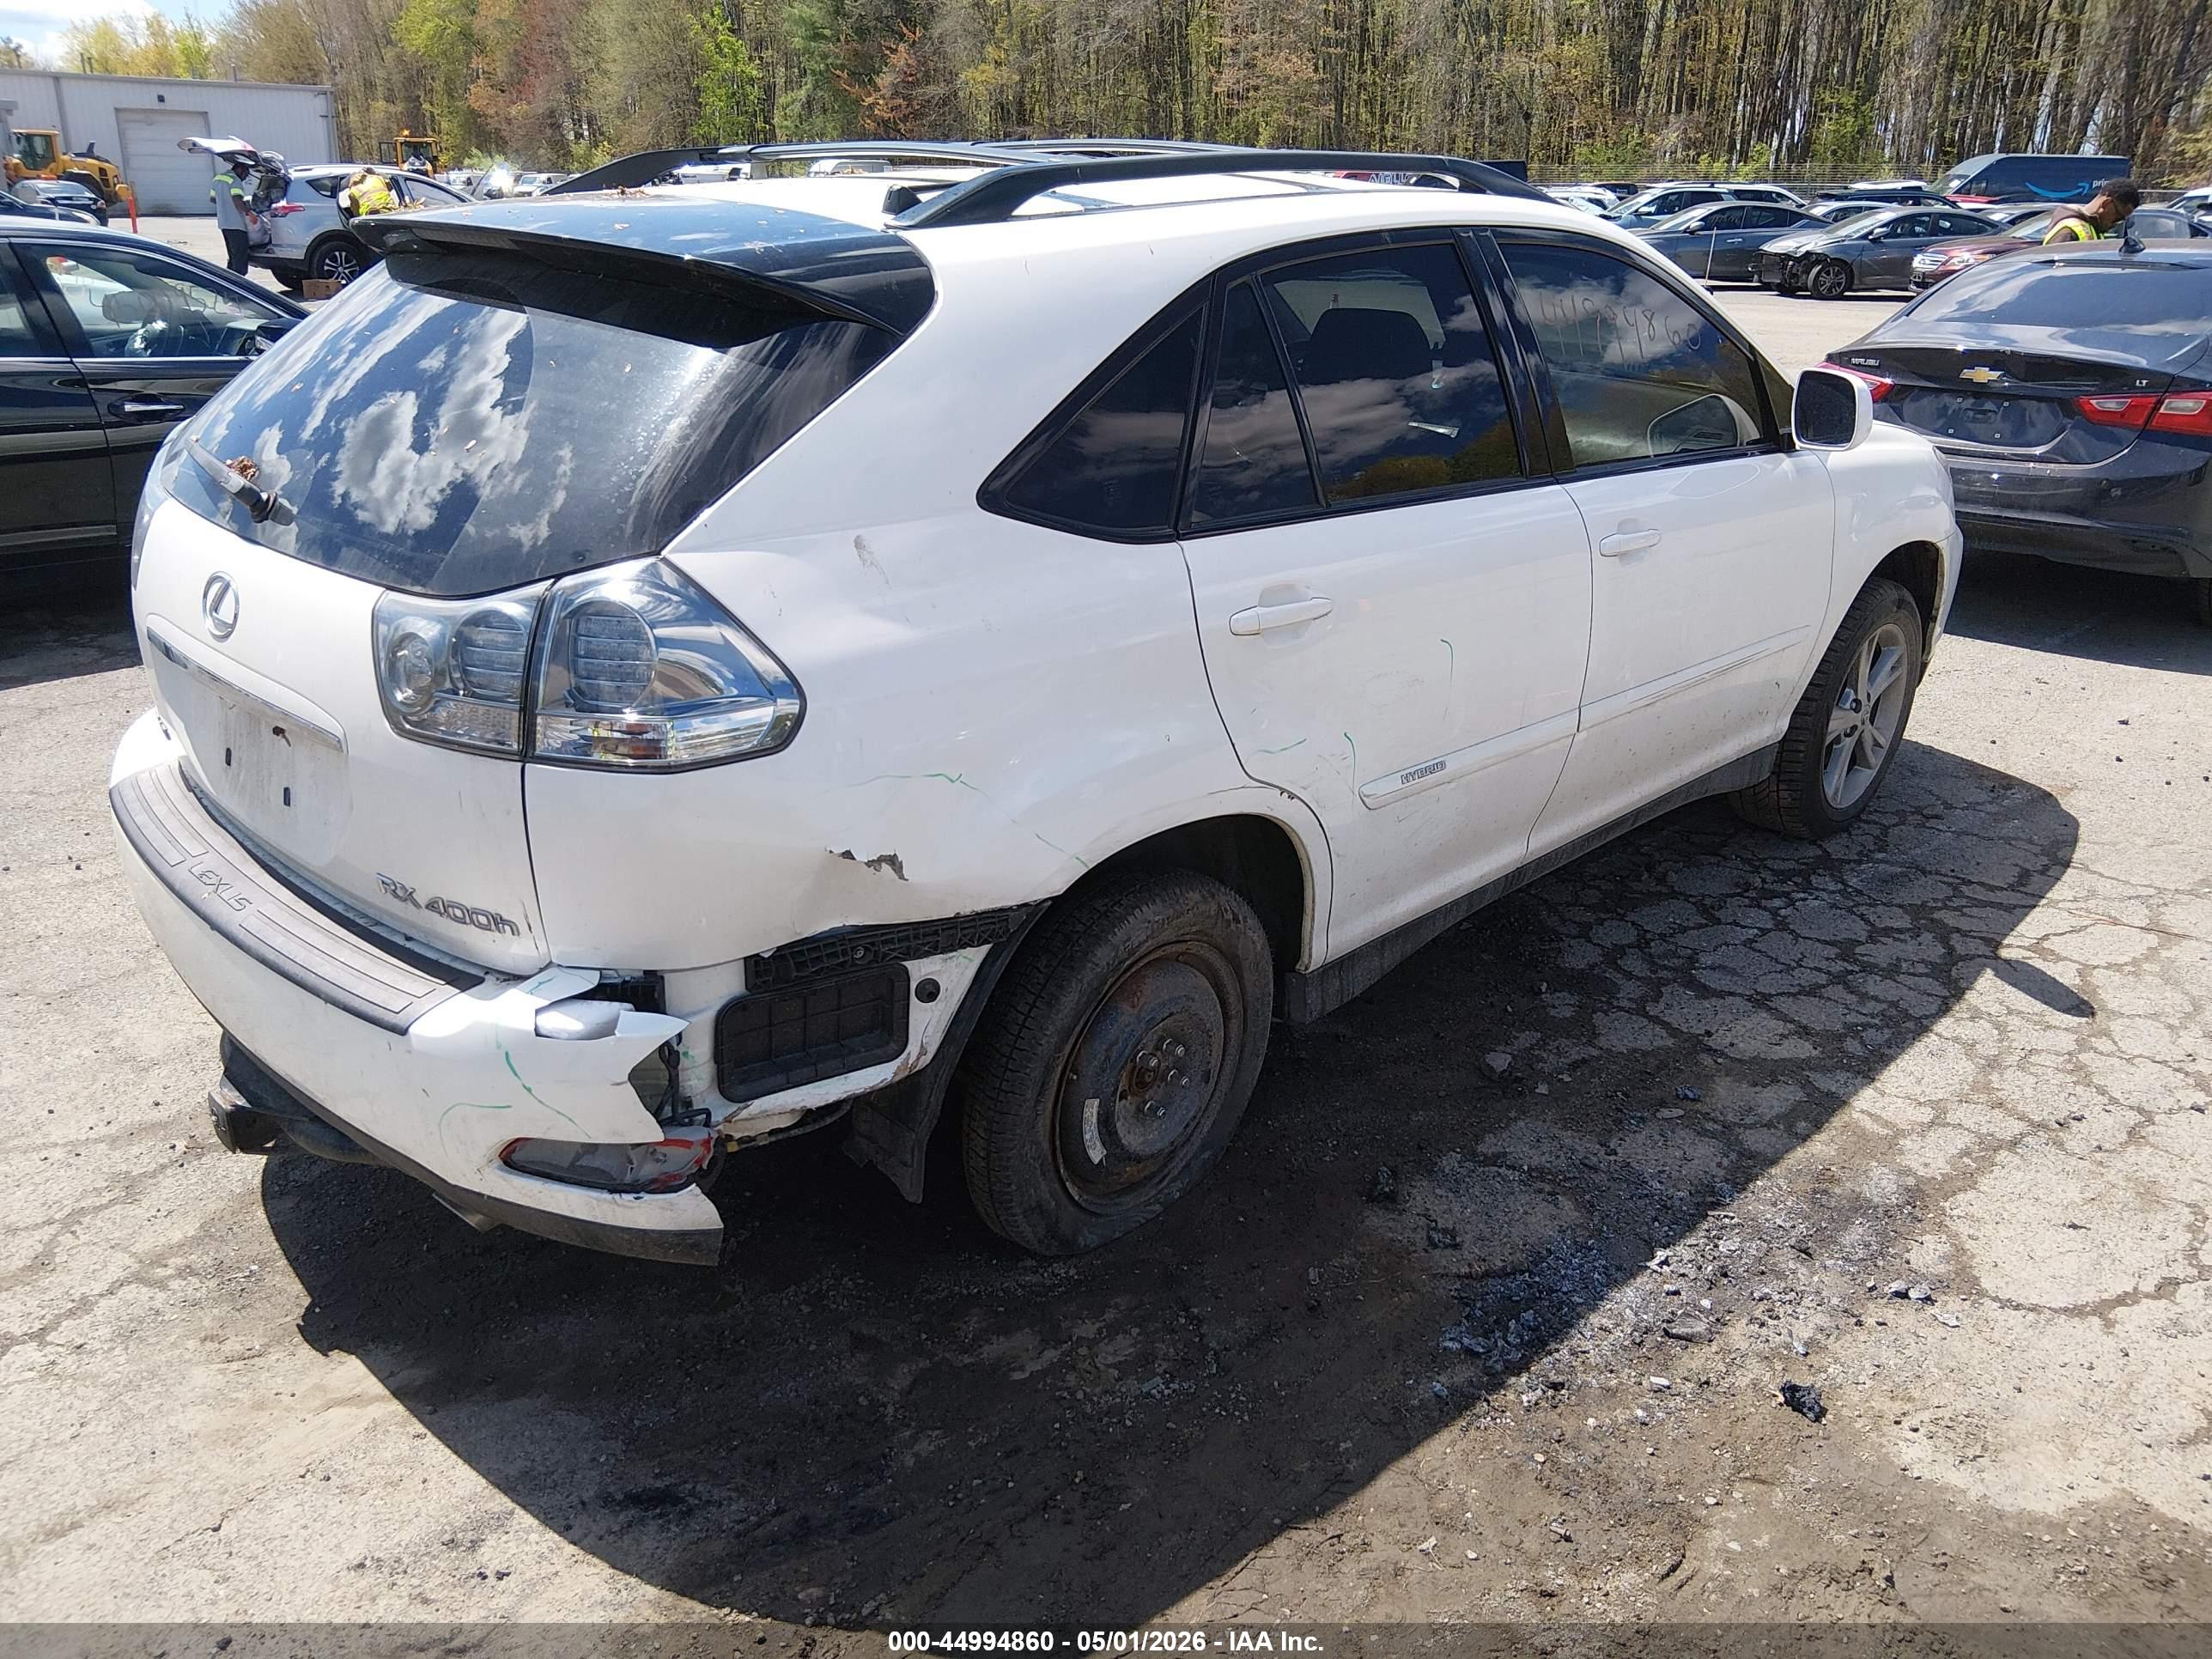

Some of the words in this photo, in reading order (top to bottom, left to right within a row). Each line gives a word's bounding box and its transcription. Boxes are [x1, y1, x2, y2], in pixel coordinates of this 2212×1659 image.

[2092, 178, 2111, 189] pri
[2136, 379, 2149, 387] LT
[188, 861, 253, 912] LEXUS
[376, 872, 423, 910] RX
[425, 896, 521, 937] 400h
